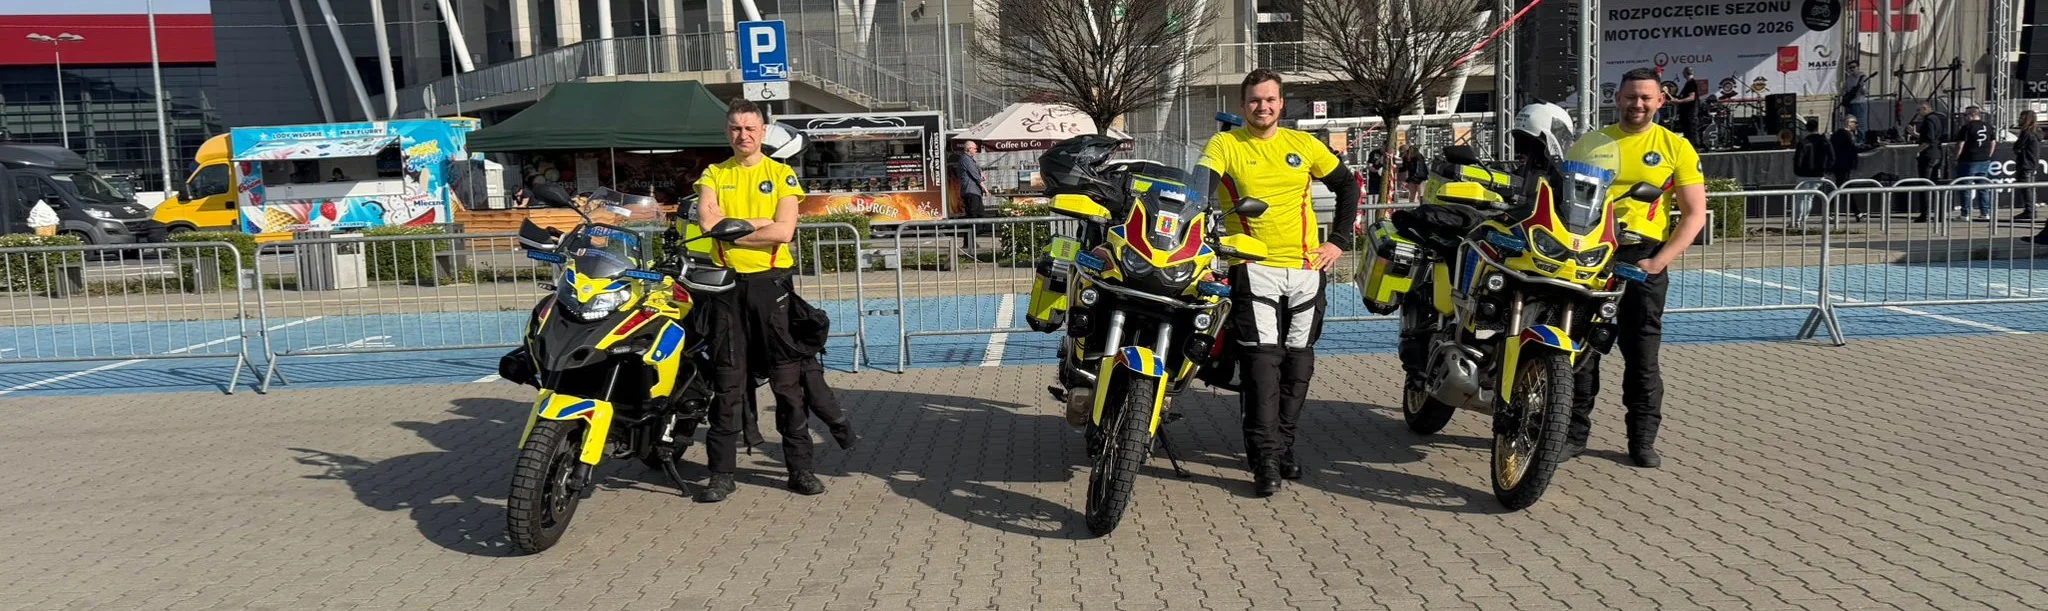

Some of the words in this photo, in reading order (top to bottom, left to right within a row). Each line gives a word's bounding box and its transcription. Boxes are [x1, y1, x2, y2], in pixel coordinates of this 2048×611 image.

[1608, 4, 1720, 20] ROZPOCZĘCIE
[1724, 0, 1791, 15] SEZONU
[1604, 22, 1752, 42] MOTOCYKLOWEGO
[1757, 20, 1794, 34] 2026
[749, 26, 777, 63] P
[1671, 54, 1713, 64] VEOLIA
[1314, 103, 1326, 114] B3
[995, 141, 1019, 150] Coffee
[1030, 140, 1042, 148] Go
[856, 197, 899, 219] BURGER
